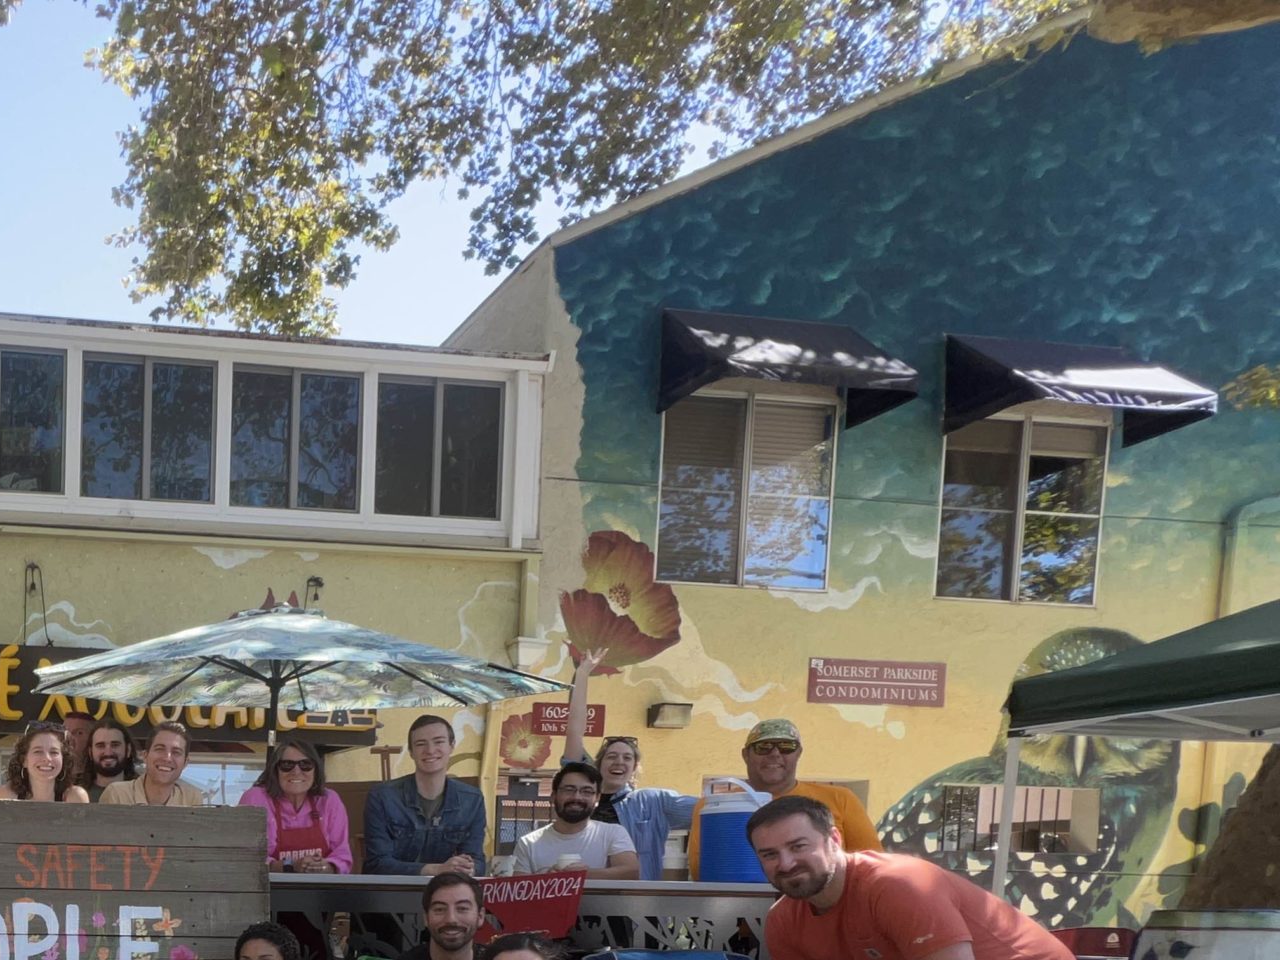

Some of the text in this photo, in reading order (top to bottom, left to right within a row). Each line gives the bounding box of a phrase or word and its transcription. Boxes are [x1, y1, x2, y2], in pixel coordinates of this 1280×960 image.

[816, 664, 938, 681] SOMERSET PARKSIDE
[815, 685, 938, 701] CONDOMINIUMS
[15, 844, 166, 891] SAFETY
